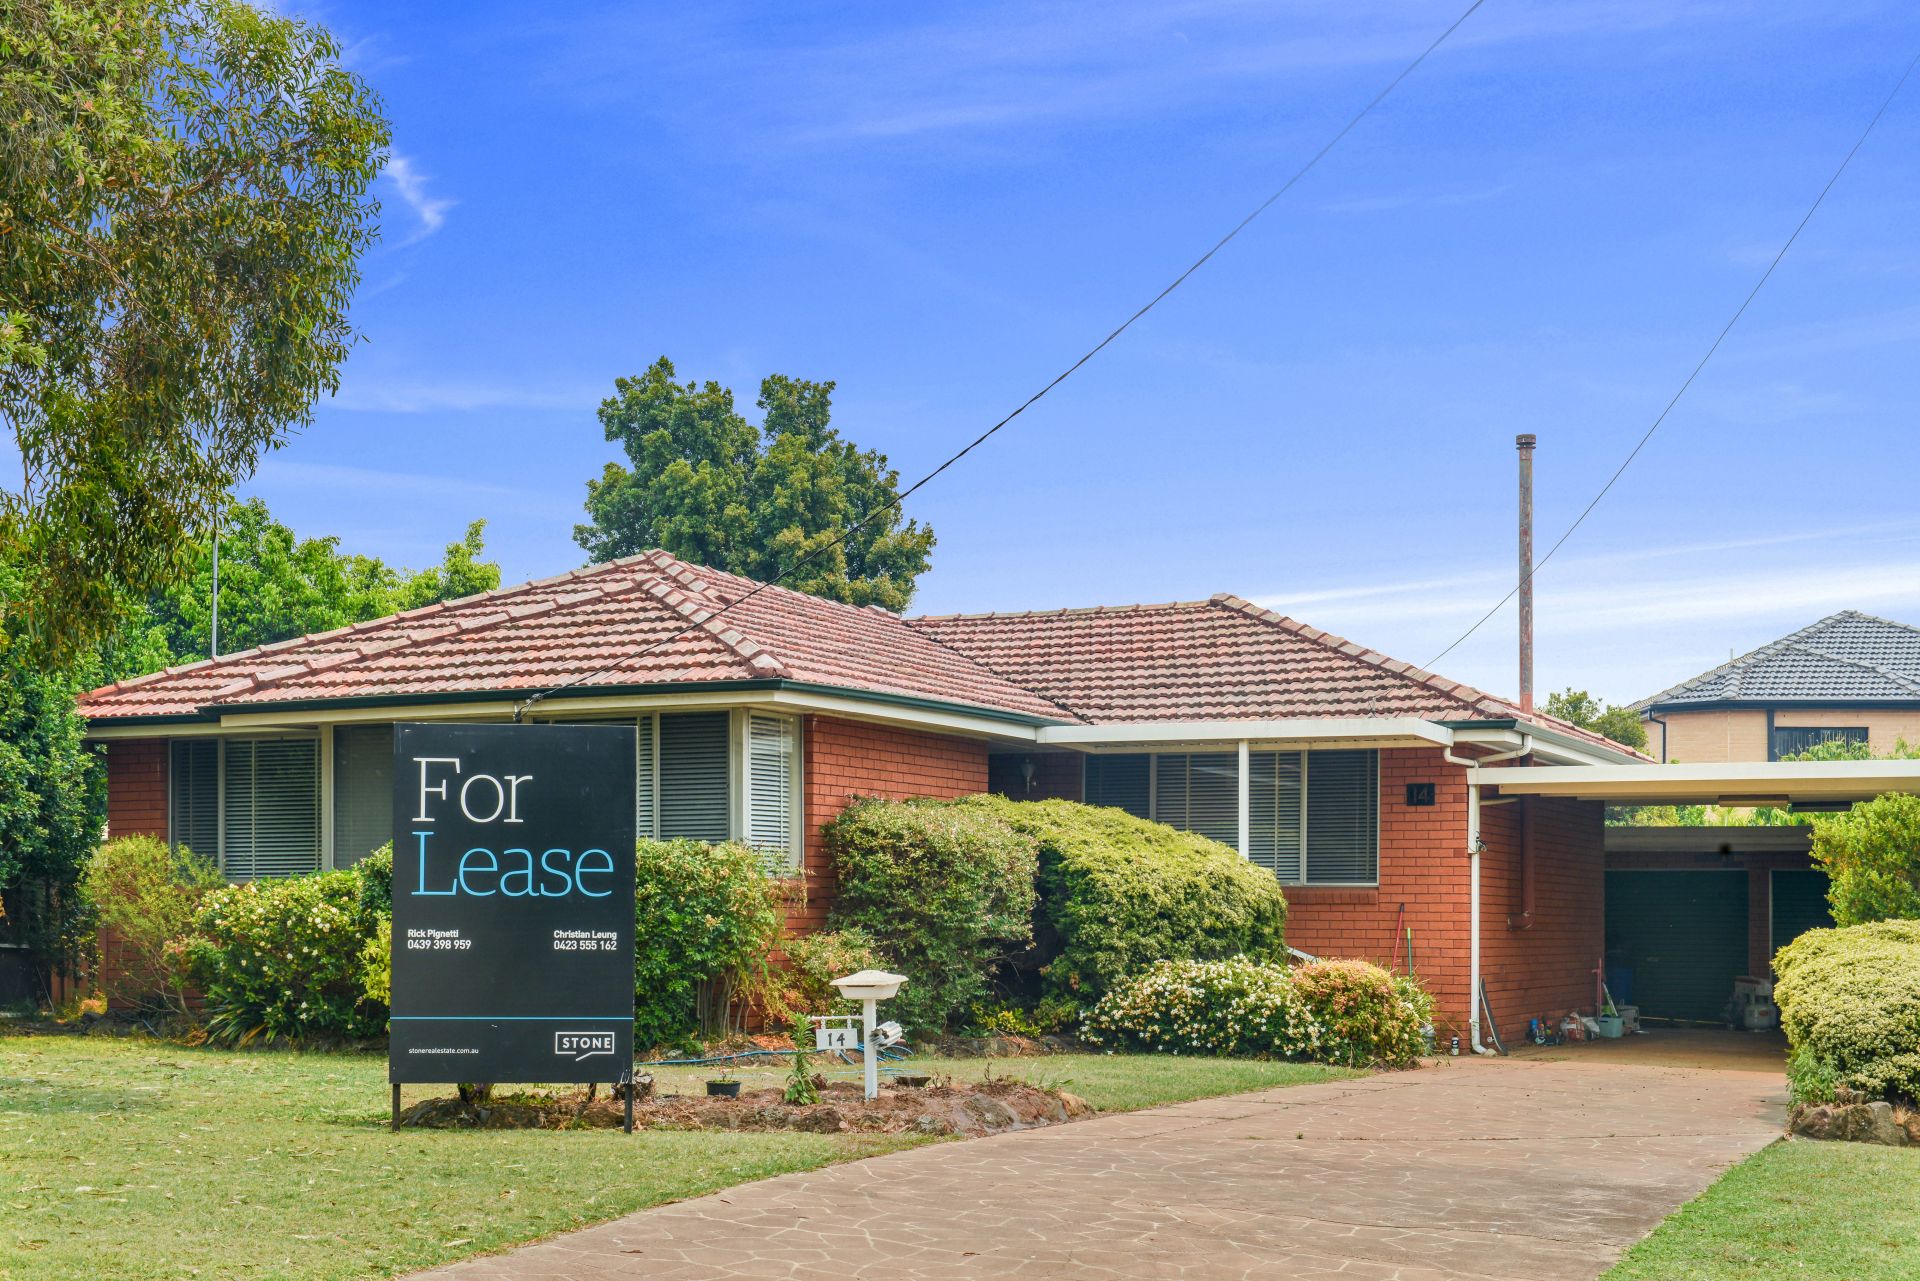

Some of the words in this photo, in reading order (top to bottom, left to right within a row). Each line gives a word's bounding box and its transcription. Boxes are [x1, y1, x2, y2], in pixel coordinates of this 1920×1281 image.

[412, 757, 533, 823] For
[1412, 786, 1430, 803] 14
[411, 831, 614, 897] Lease
[407, 929, 426, 938] Rick
[427, 929, 459, 940] Pignetti
[553, 930, 590, 939] Christian
[592, 930, 617, 940] Leung
[407, 939, 431, 950] 0439
[433, 939, 452, 950] 398
[453, 939, 472, 950] 959
[553, 940, 577, 950] 0423
[579, 940, 597, 950] 555
[600, 940, 617, 950] 162
[562, 1037, 611, 1049] STONE
[827, 1032, 845, 1047] 14
[408, 1047, 479, 1055] stonerealestate.com.au
